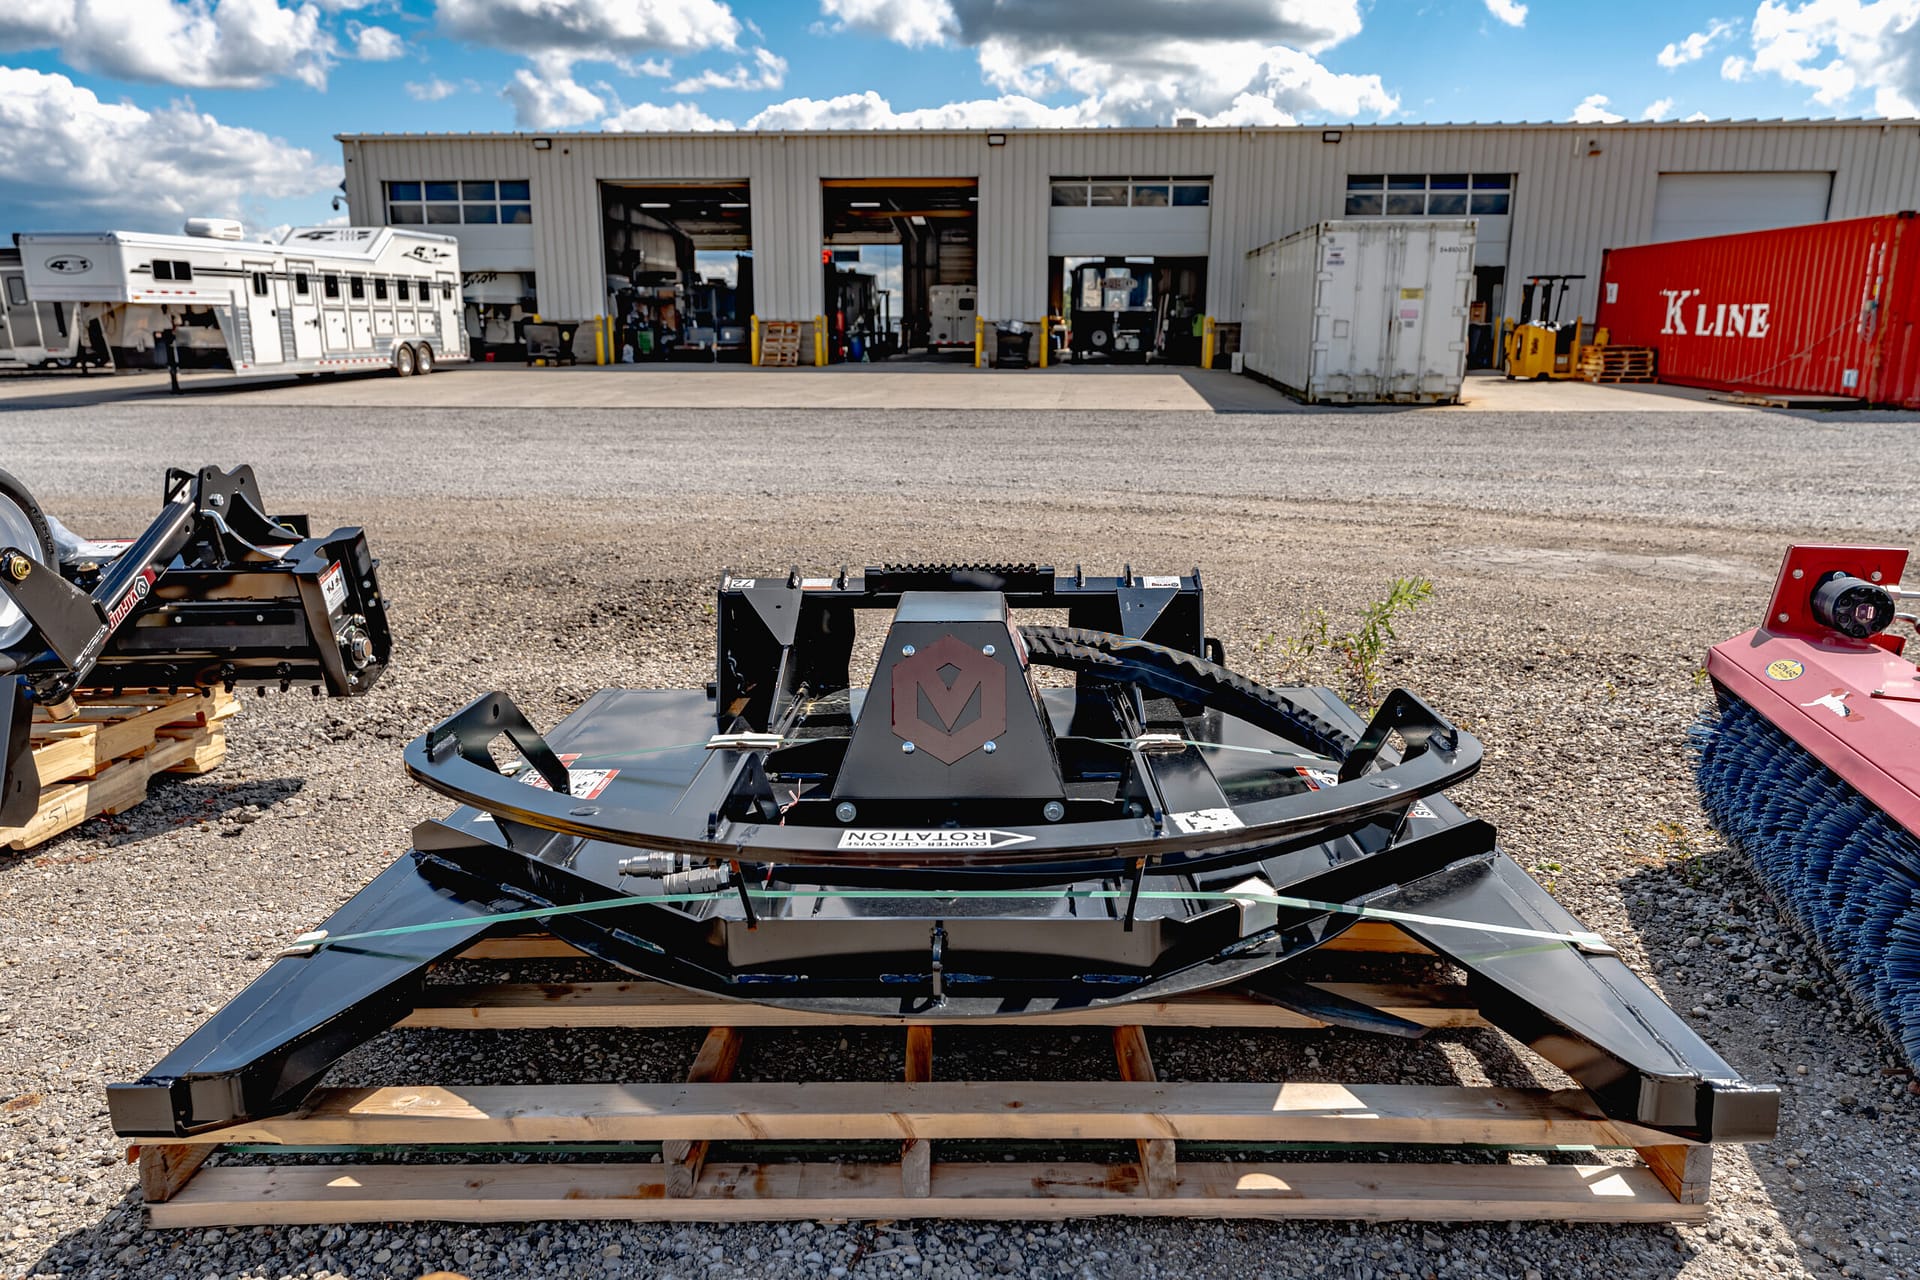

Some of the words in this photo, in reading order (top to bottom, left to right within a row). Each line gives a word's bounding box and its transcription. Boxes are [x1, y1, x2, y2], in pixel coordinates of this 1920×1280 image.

[1695, 303, 1770, 338] LINE
[733, 580, 752, 588] 72
[847, 831, 986, 841] ROTATION
